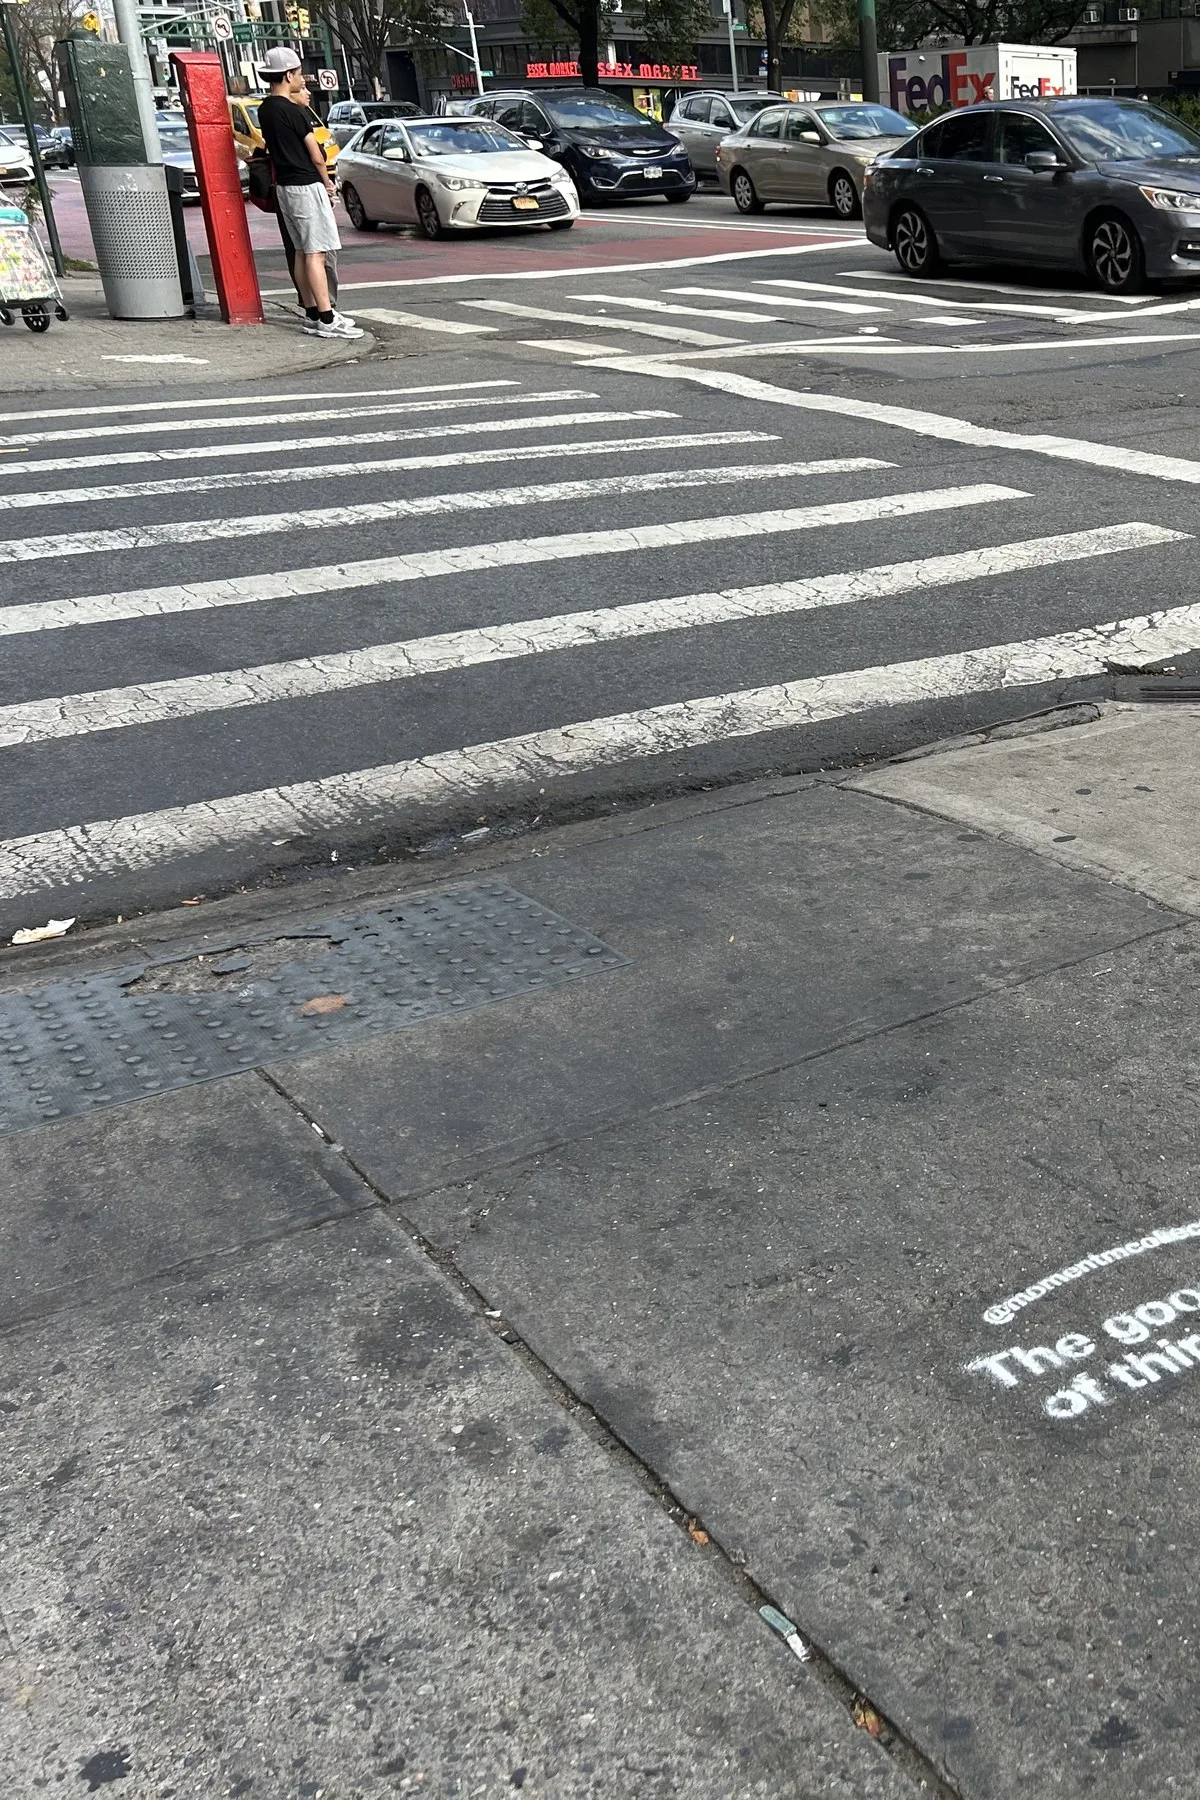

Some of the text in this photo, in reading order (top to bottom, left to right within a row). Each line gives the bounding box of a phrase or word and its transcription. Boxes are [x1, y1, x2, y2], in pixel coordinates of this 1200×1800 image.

[598, 62, 633, 76] SSEX
[888, 52, 996, 112] FedEx
[1011, 76, 1066, 99] FedEx
[966, 1331, 1097, 1388] The
[1043, 1371, 1111, 1419] of
